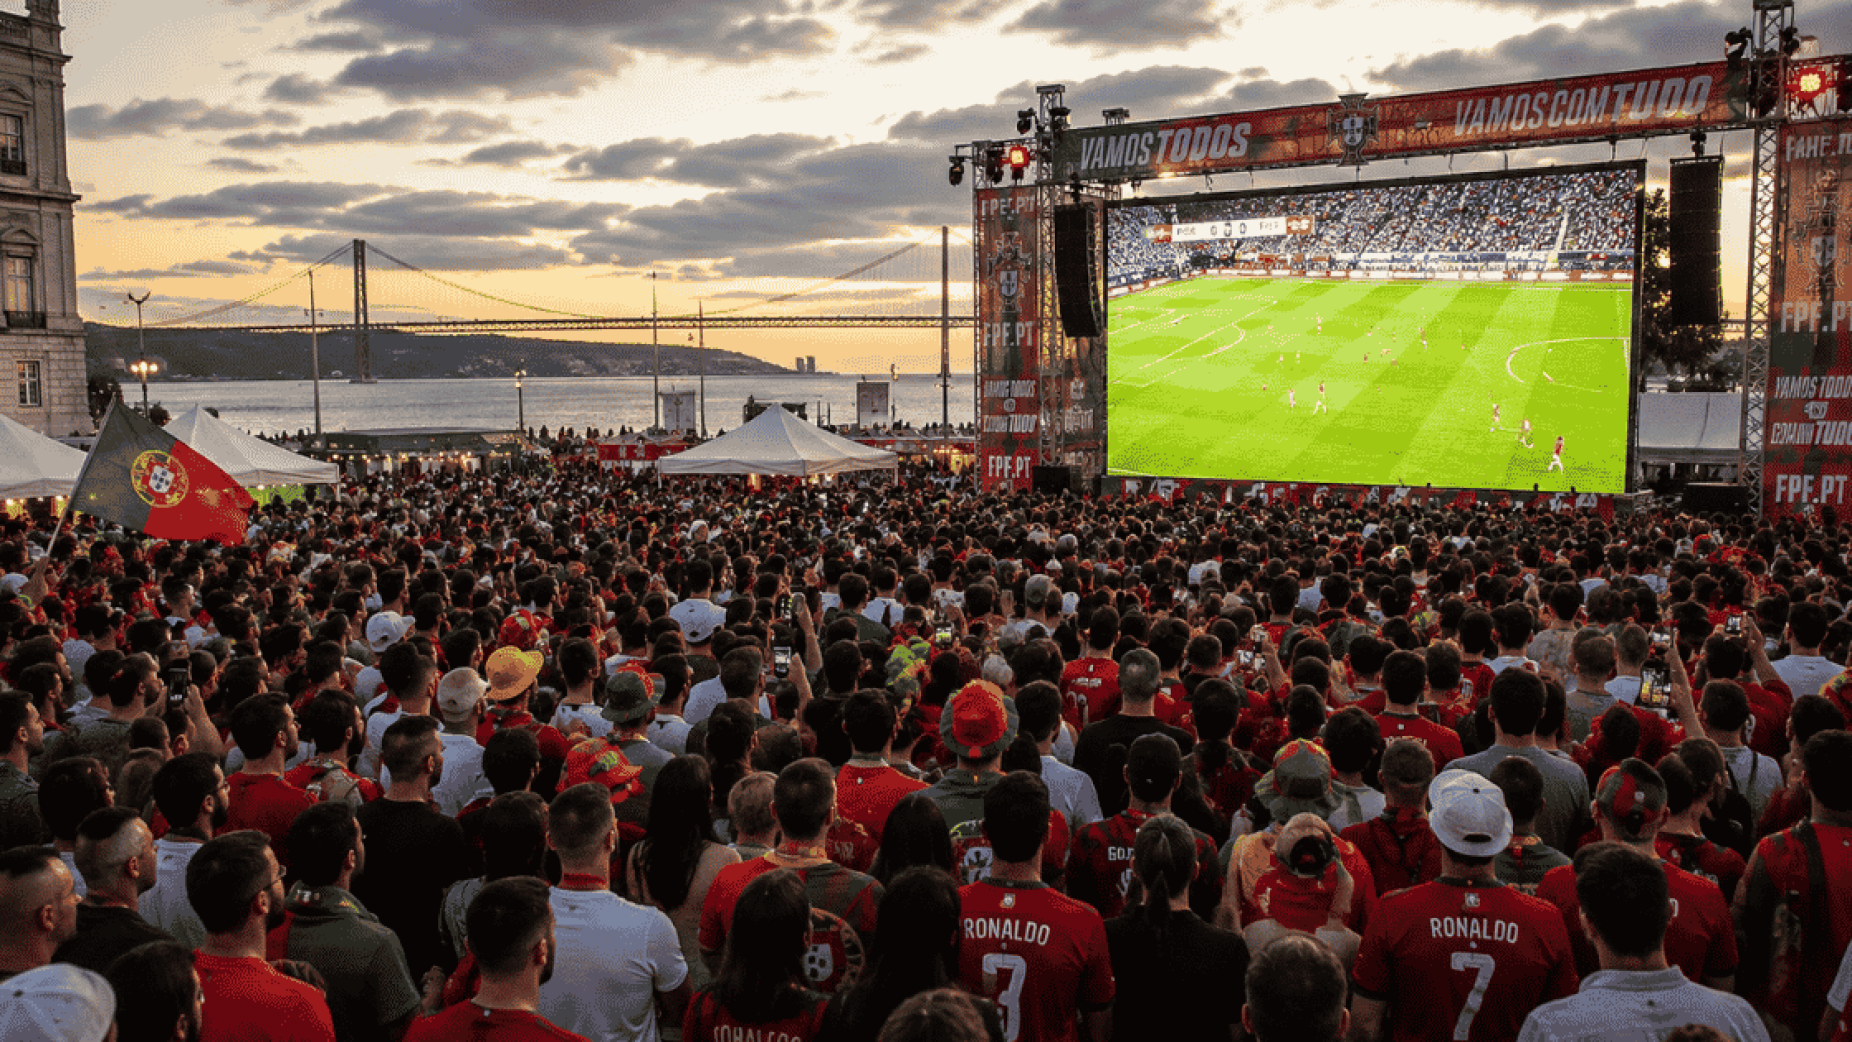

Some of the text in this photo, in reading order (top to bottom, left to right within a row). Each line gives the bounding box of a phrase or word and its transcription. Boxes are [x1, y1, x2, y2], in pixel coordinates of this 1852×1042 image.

[988, 456, 1031, 478] FPF.PT
[1776, 474, 1847, 504] FPF.PT
[964, 918, 1050, 946] RONALDO
[1430, 916, 1518, 944] RONALDO
[1451, 952, 1495, 1041] 7
